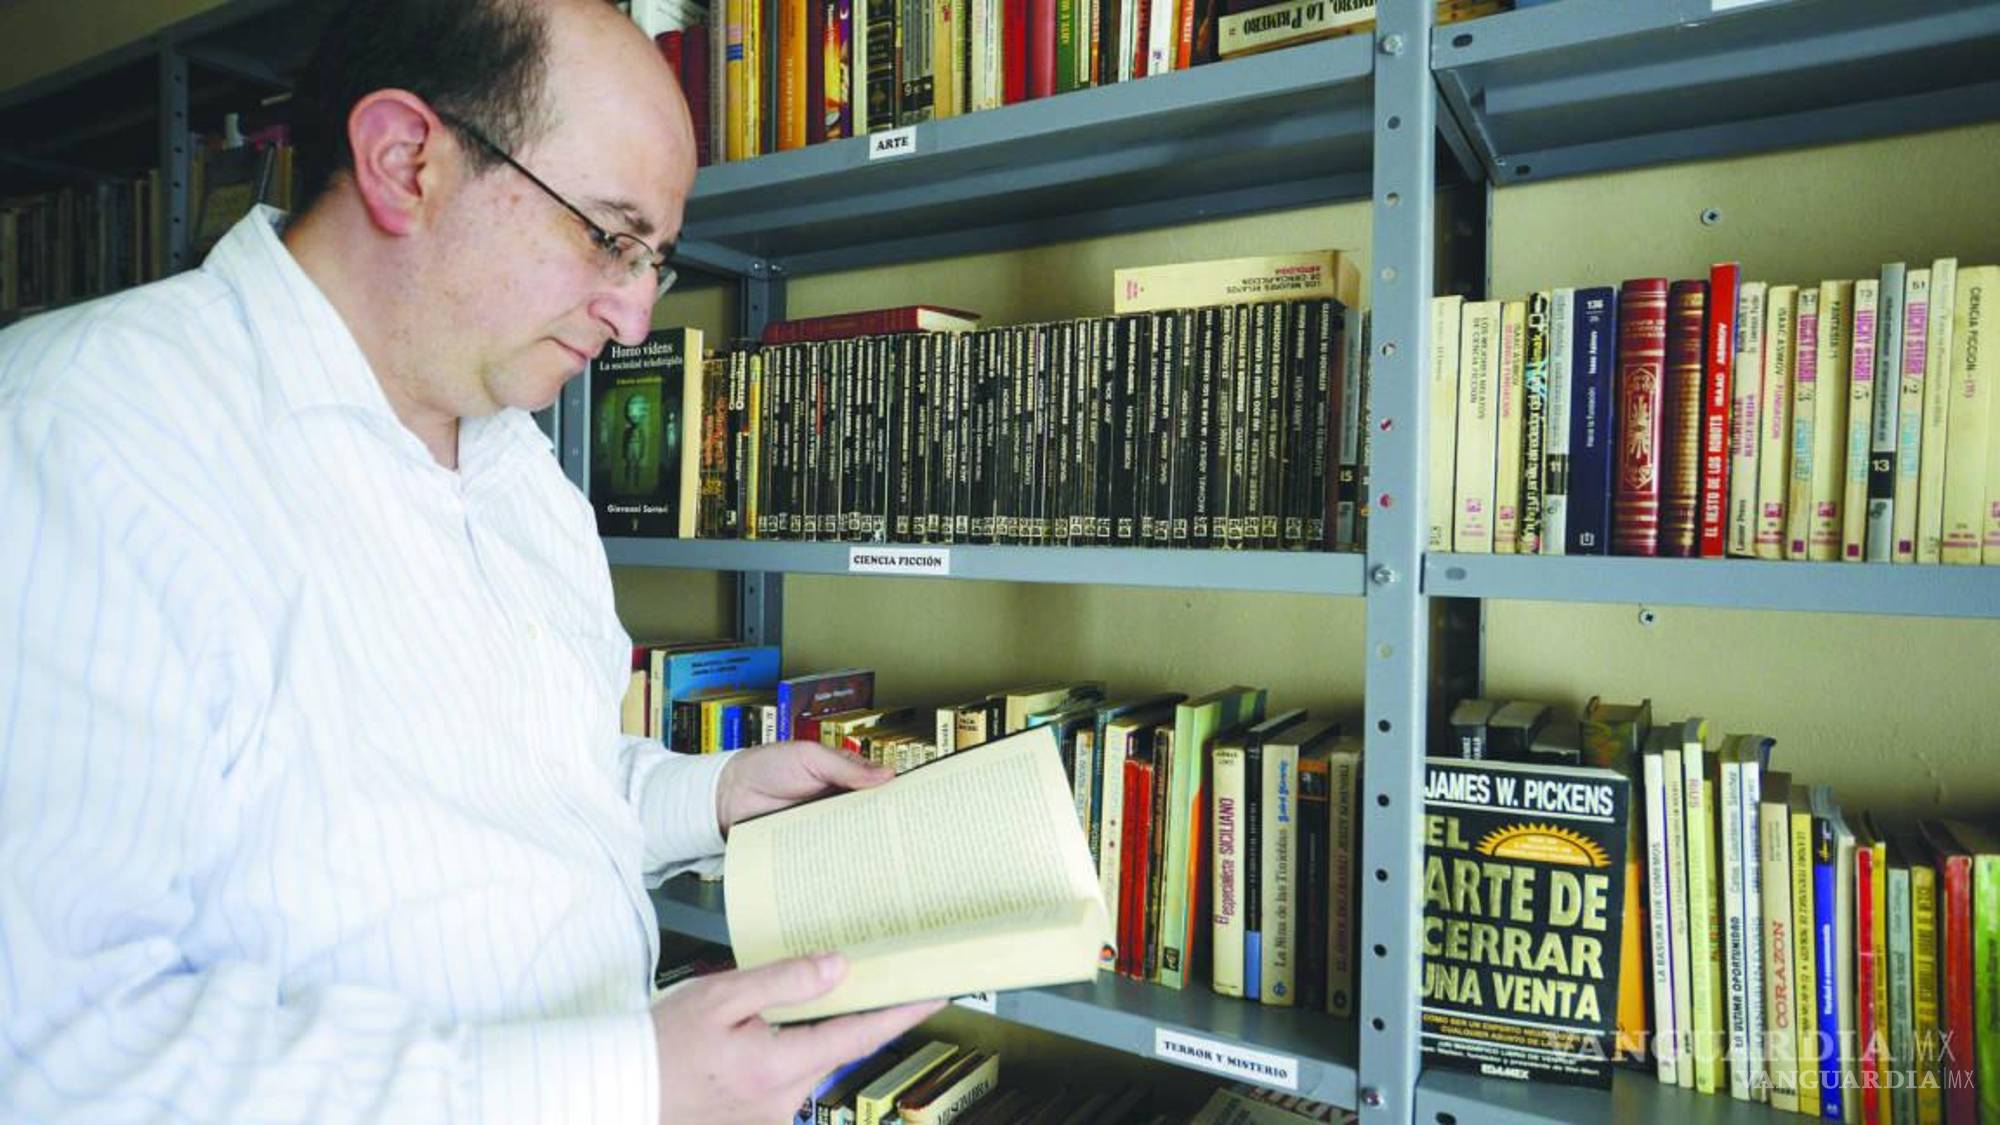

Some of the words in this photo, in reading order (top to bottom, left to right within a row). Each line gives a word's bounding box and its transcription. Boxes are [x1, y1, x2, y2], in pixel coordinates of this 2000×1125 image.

[1243, 7, 1302, 34] PRIMERO
[876, 136, 909, 151] ARTE
[1776, 307, 1785, 335] ISAAC
[1907, 302, 1926, 337] LUCKY
[1968, 287, 1981, 327] CIENCIA
[1799, 314, 1816, 347] LUCKY
[1830, 301, 1839, 348] FANTASIA
[1857, 310, 1873, 342] LUCKY
[643, 342, 673, 355] videns
[1590, 330, 1599, 354] Asimov
[1716, 322, 1728, 365] ASIMOV
[1774, 338, 1784, 375] ASIMOV
[1904, 339, 1925, 376] STARR
[1966, 330, 1979, 372] FICCION
[600, 360, 611, 371] La
[1589, 356, 1598, 374] Isaac
[1854, 347, 1872, 381] STARR
[1586, 386, 1596, 420] Fundación
[1715, 373, 1726, 406] ISAAC
[1772, 384, 1782, 439] FUNDACION
[1709, 414, 1723, 452] ROBOTS
[1124, 440, 1132, 469] ROBERT
[1235, 453, 1243, 477] JOHN
[1709, 456, 1721, 474] LOS
[1873, 459, 1890, 472] 13
[1198, 475, 1207, 513] MICHAEL
[1250, 479, 1258, 511] ROBERT
[1708, 477, 1720, 489] DE
[607, 504, 641, 513] Giovanni
[1707, 492, 1720, 523] RESTO
[1737, 500, 1747, 522] Press
[1706, 526, 1718, 537] EL
[854, 555, 896, 565] CIENCIA
[899, 556, 942, 566] FICCIÓN
[1424, 771, 1490, 804] JAMES
[1496, 777, 1519, 807] W.
[1524, 782, 1614, 816] PICKENS
[1219, 797, 1235, 855] SICILIANO
[1424, 815, 1469, 850] EL
[1274, 829, 1287, 882] Tinieblas
[1650, 841, 1664, 897] COMEMOS
[1275, 885, 1286, 902] las
[1424, 855, 1536, 923] ARTE
[1549, 870, 1609, 932] DE
[1652, 899, 1665, 920] QUE
[1214, 916, 1229, 925] El
[1275, 905, 1286, 919] de
[1273, 954, 1286, 967] La
[1421, 917, 1604, 980] CERRAR
[1653, 923, 1666, 967] BASURA
[1729, 916, 1743, 992] OPORTUNIDAD
[1655, 969, 1666, 983] LA
[1772, 920, 1788, 1029] CORAZON
[1418, 964, 1483, 1007] UNA
[1493, 971, 1601, 1023] VENTA
[1731, 994, 1744, 1032] ULTIMA
[1164, 1041, 1213, 1061] TERROR
[1216, 1053, 1223, 1062] Y
[1227, 1057, 1288, 1078] MISTERIO
